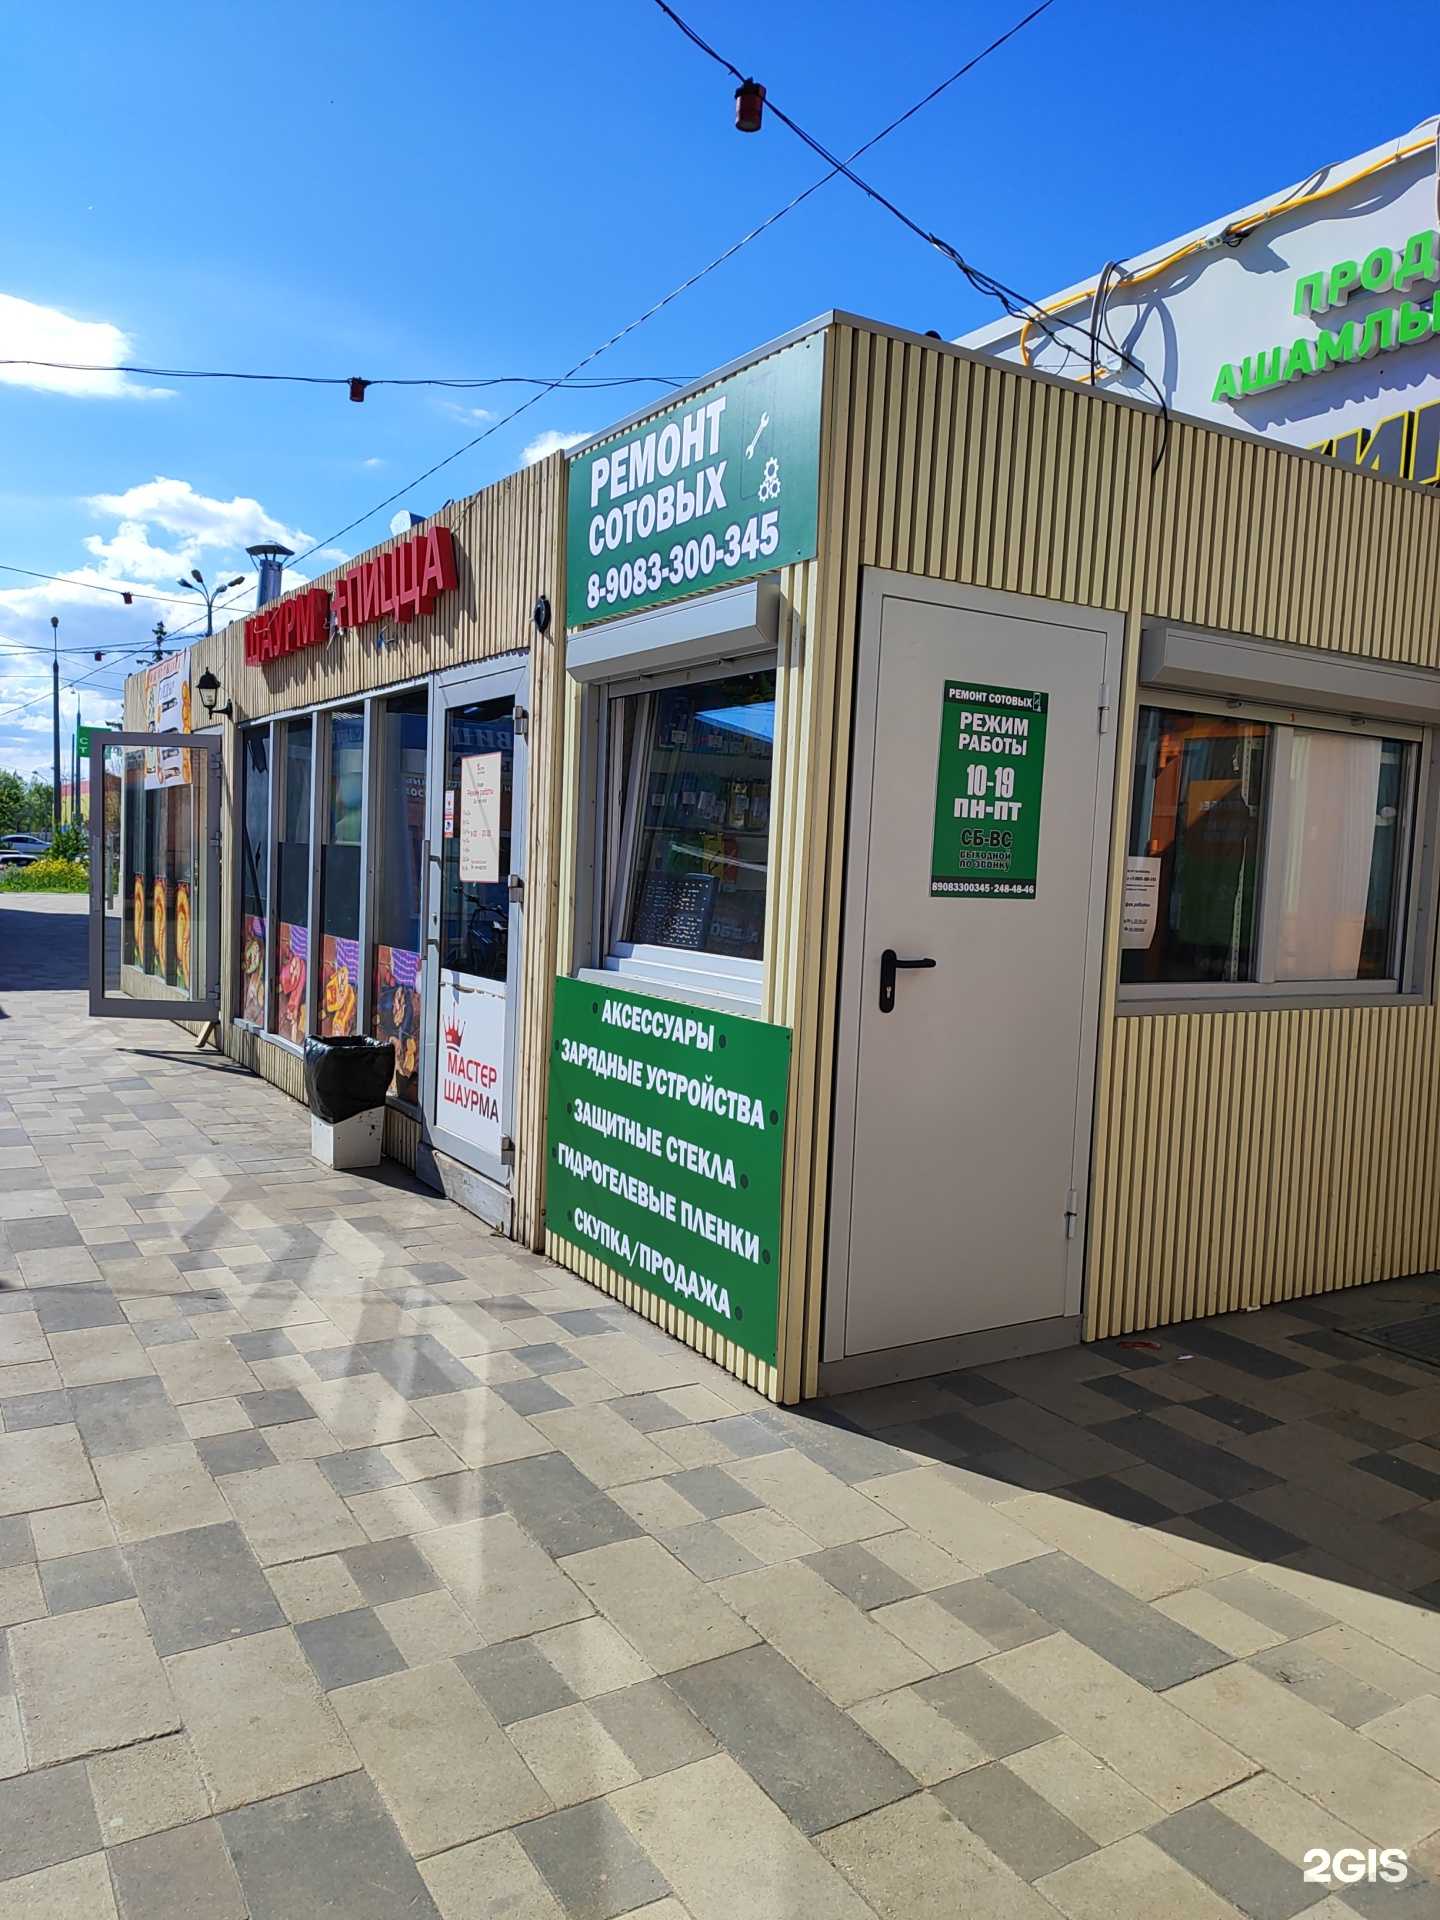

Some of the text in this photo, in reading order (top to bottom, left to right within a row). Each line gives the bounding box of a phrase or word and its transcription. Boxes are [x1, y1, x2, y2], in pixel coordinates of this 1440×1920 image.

[590, 396, 727, 509] РЕМОНТ
[588, 460, 728, 556] СОТОВЫХ
[586, 510, 780, 609] 8-9083-300-345
[949, 688, 1032, 708] РЕМОНТ СОТОВЫХ
[958, 733, 1027, 756] РАБОТЫ
[960, 711, 1029, 737] РЕЖИМ
[966, 764, 1015, 799] 10-19
[953, 798, 1022, 821] ПН-ПТ
[960, 828, 1013, 848] СБ-ВС
[601, 999, 715, 1053] АКСЕССУАРЫ
[447, 1051, 497, 1089] МАСТЕР
[561, 1037, 765, 1130] ЗАРЯДНЫЕ УСТРОЙСТВА
[444, 1078, 499, 1123] ШАУРМА
[573, 1097, 736, 1189] ЗАЩИТНЫЕ СТЕКЛА
[557, 1141, 761, 1264] ГИДРОГЕЛЕВЫЕ ПЛЕНКИ
[574, 1207, 731, 1319] СКУПКА/ПРОДАЖА
